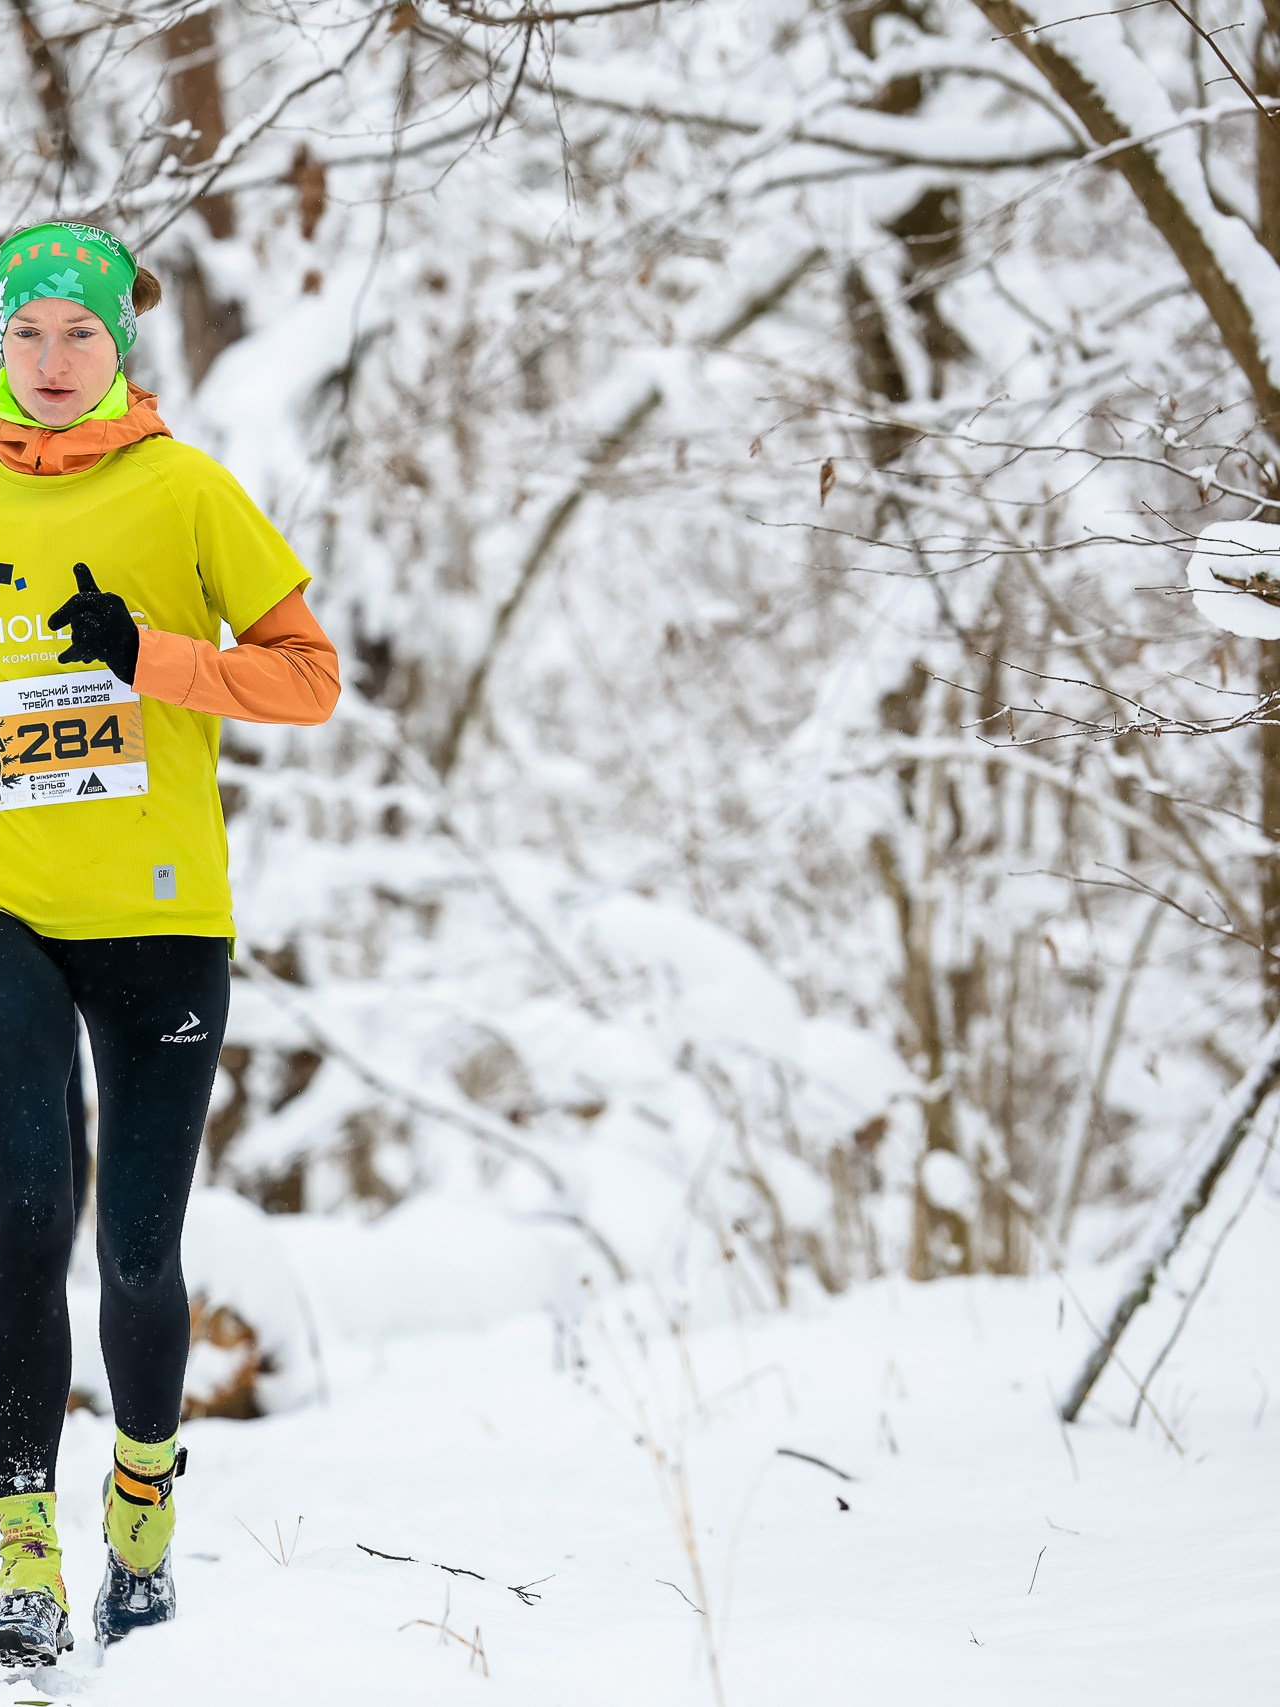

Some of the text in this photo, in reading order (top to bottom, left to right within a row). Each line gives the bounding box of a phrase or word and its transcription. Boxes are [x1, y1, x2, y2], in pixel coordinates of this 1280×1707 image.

[7, 242, 111, 275] ATLET
[2, 651, 61, 664] компан
[18, 679, 113, 700] ТУЛЬСКИЙ ЗИМНИЙ
[22, 693, 110, 710] ТРЕЙЛ 05.01.2026
[17, 715, 124, 764] 284
[160, 1031, 209, 1043] DEMIX
